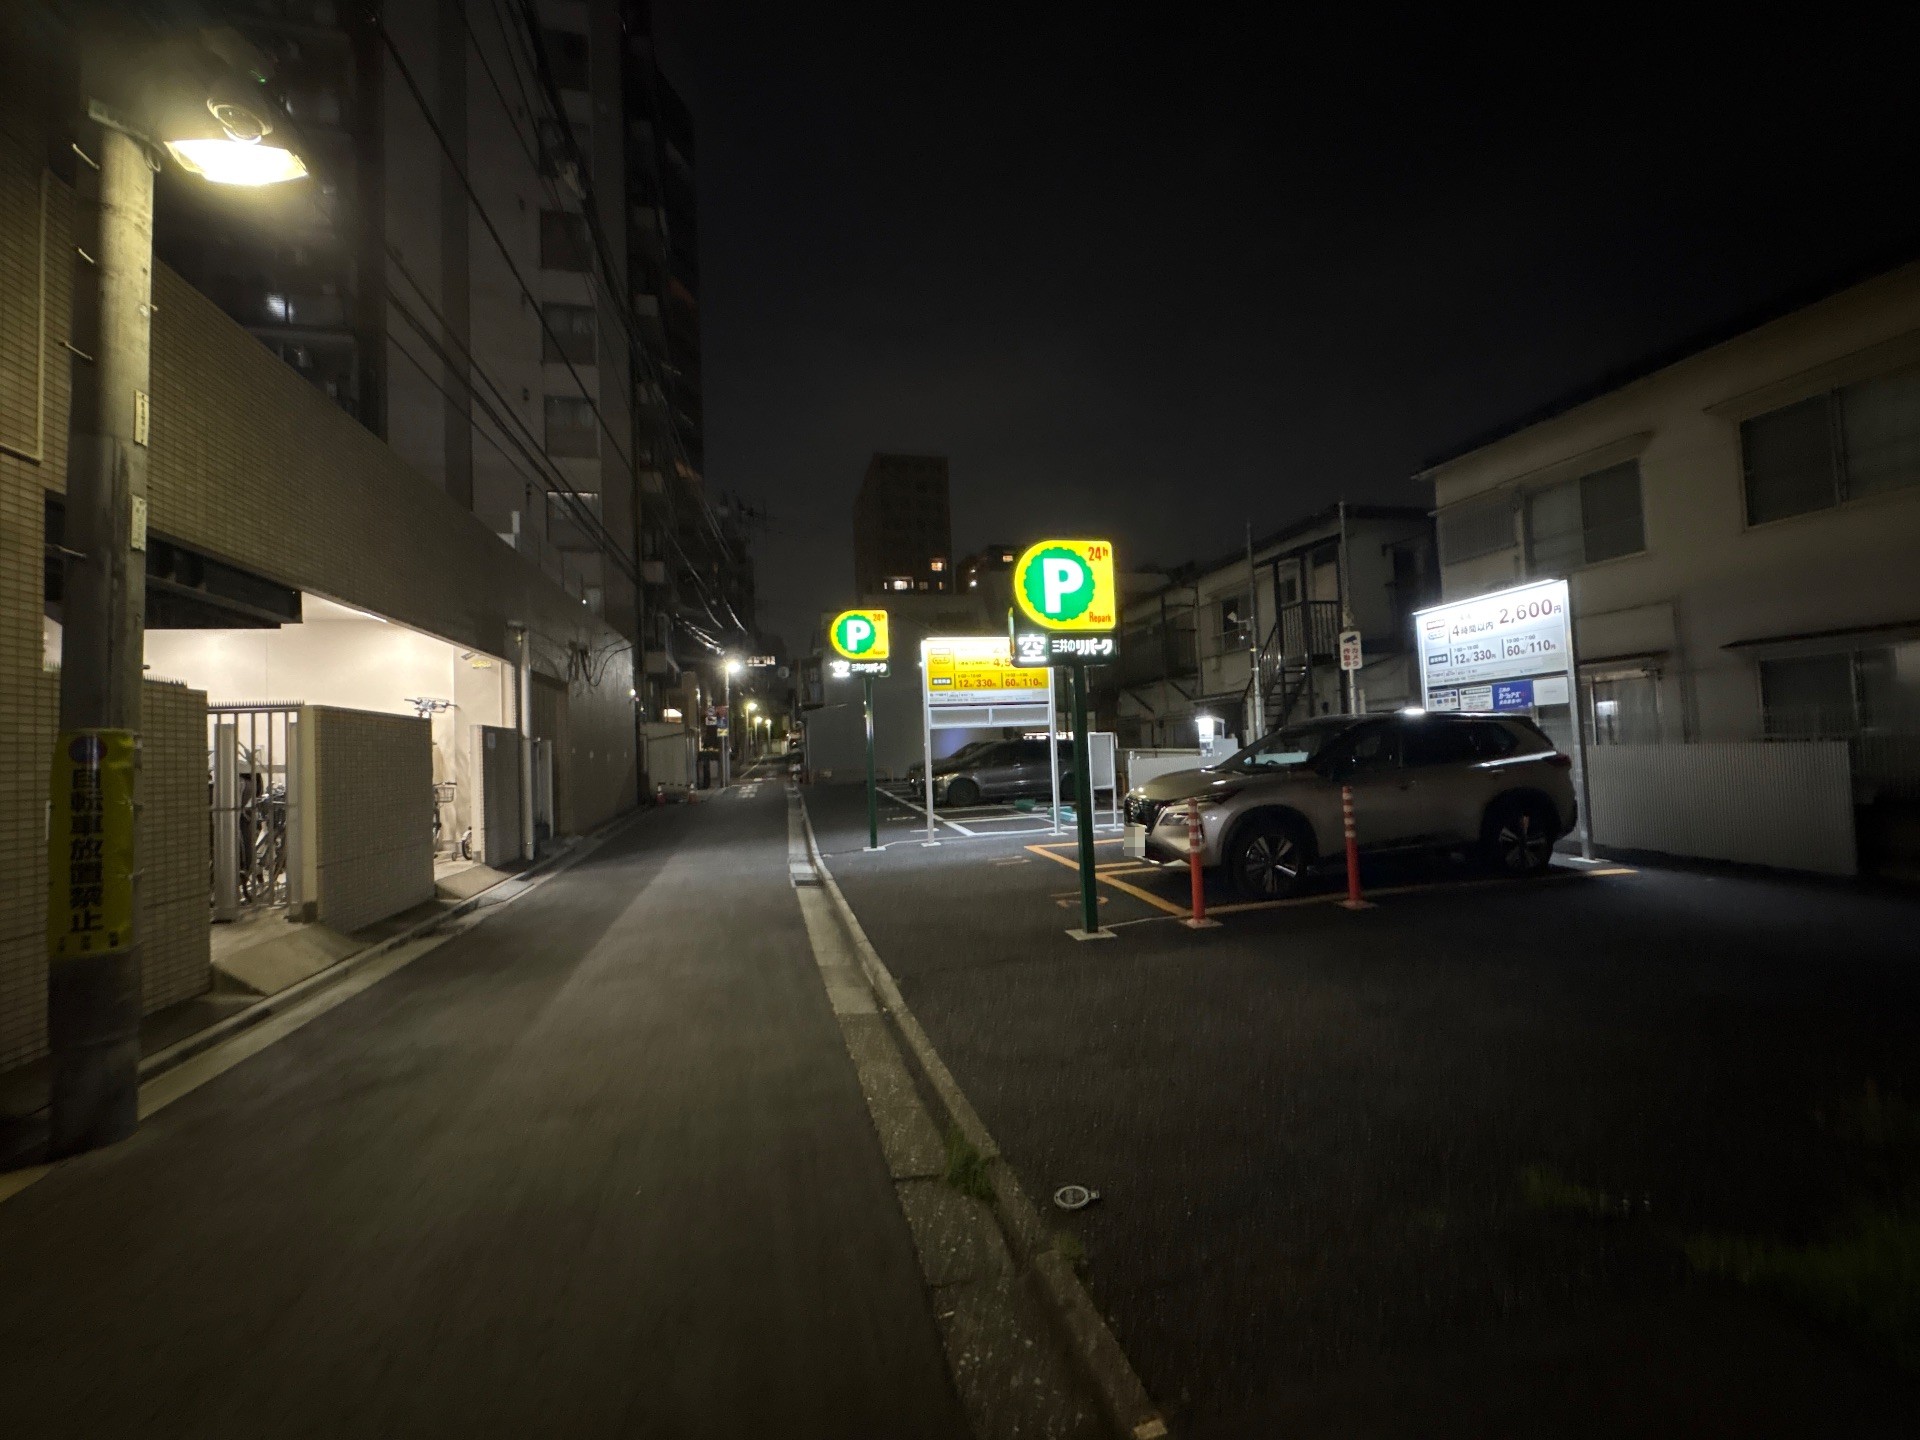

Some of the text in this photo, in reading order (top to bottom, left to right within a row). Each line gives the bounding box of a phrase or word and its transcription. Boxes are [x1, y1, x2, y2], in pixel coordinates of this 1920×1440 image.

[1043, 557, 1084, 614] P
[1499, 598, 1562, 624] 2,600円
[846, 620, 871, 651] P
[1018, 634, 1047, 662] 空
[1052, 638, 1113, 656] 三井のリパーク
[70, 768, 104, 932] 自転車放置禁止
